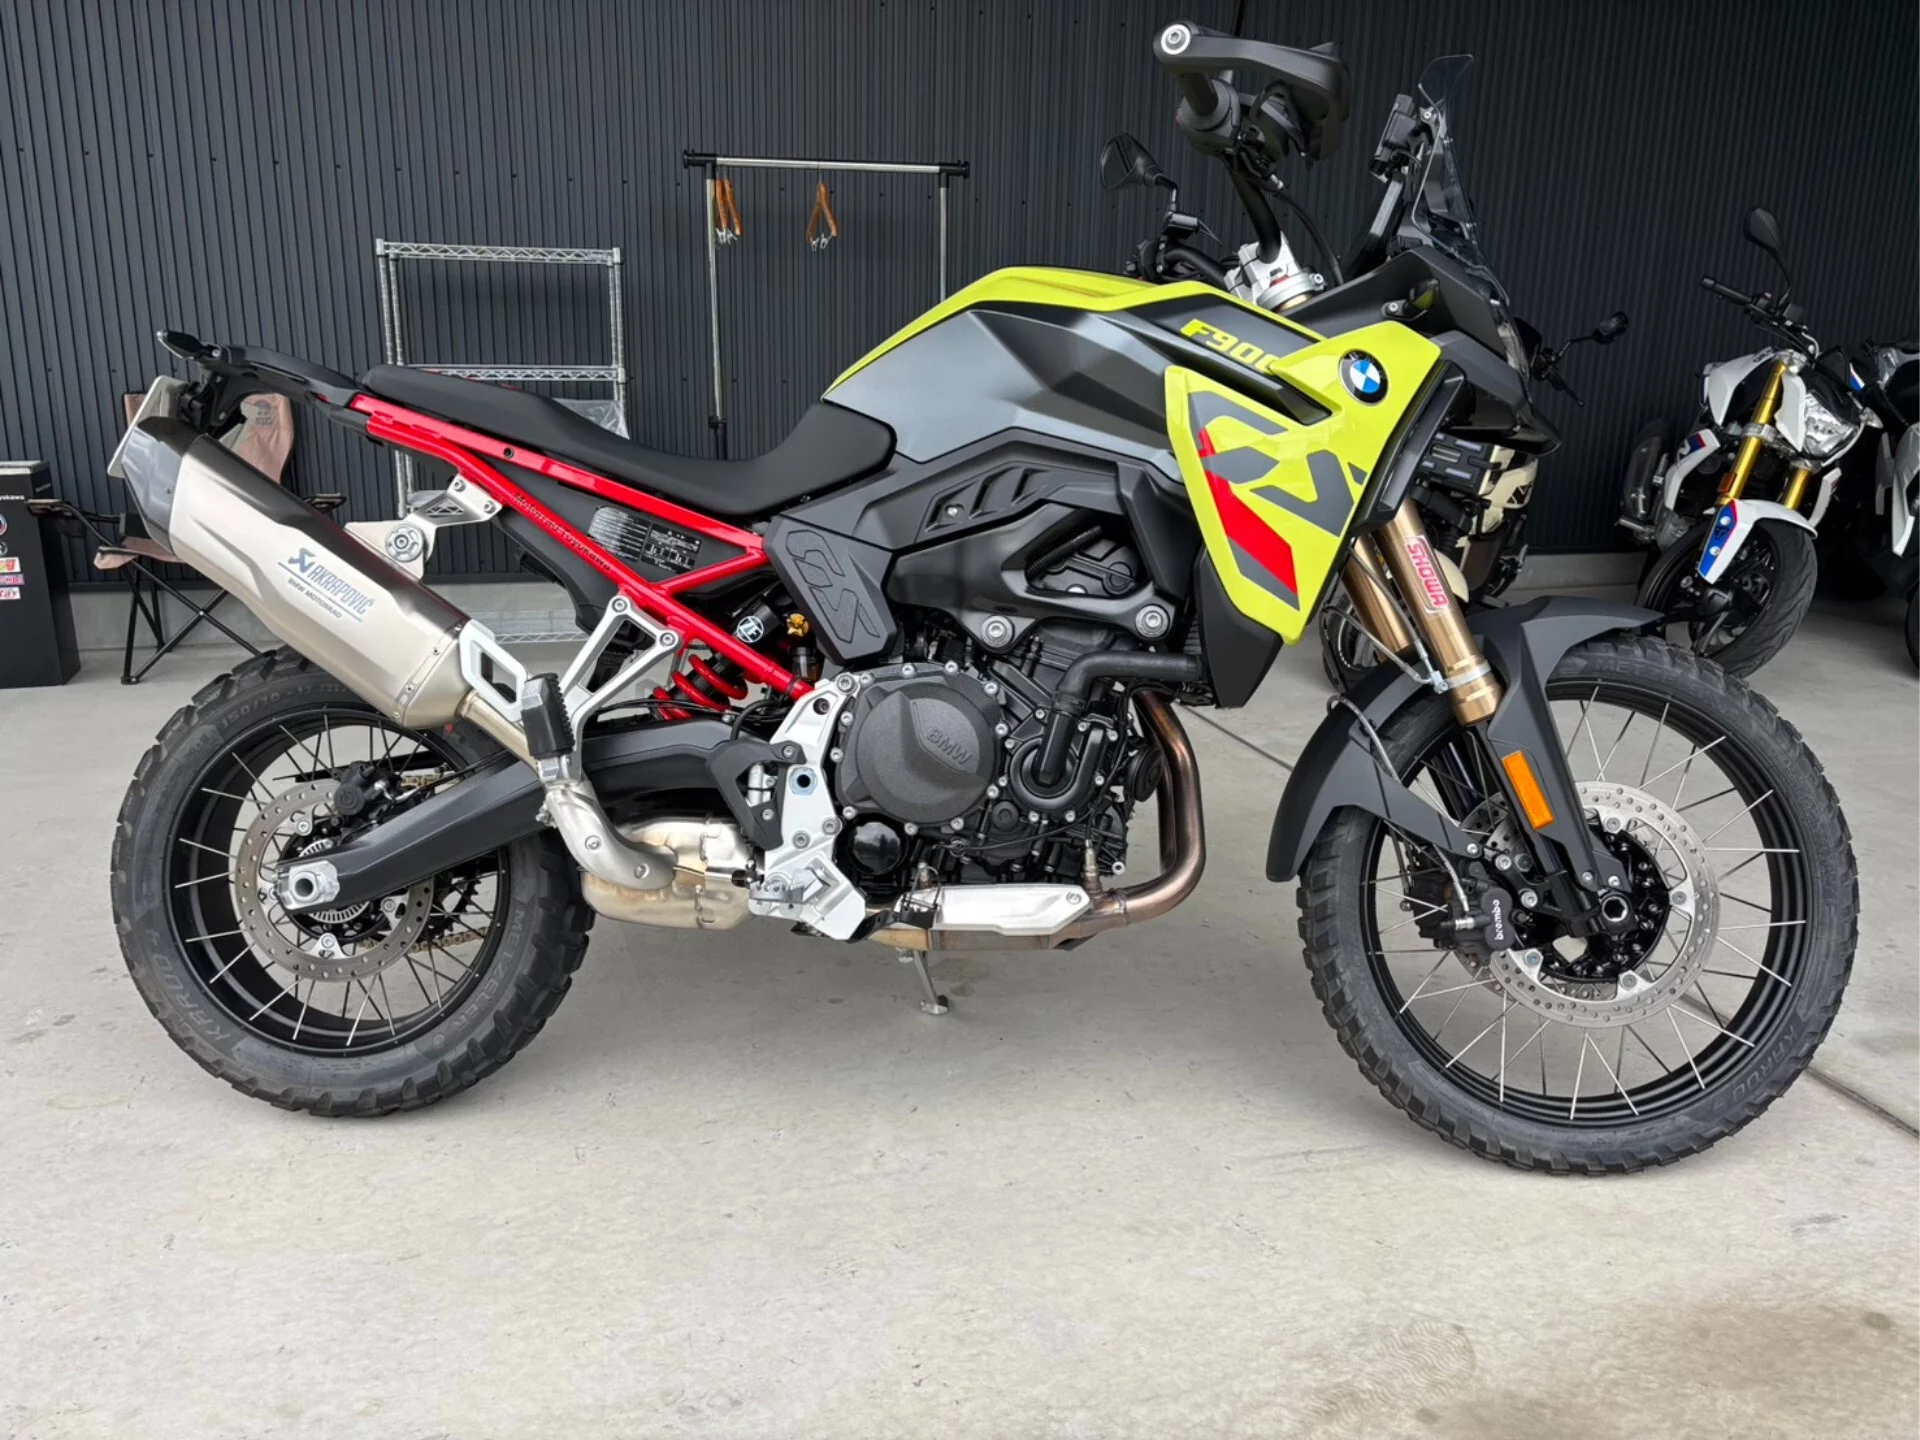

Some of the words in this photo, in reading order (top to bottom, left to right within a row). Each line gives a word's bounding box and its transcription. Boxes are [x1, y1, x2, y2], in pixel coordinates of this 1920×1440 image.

[1407, 542, 1450, 608] SHOWA
[287, 577, 305, 594] BMW
[304, 589, 343, 619] MOTORRAD
[925, 727, 972, 765] BMW
[1491, 898, 1505, 941] brembo
